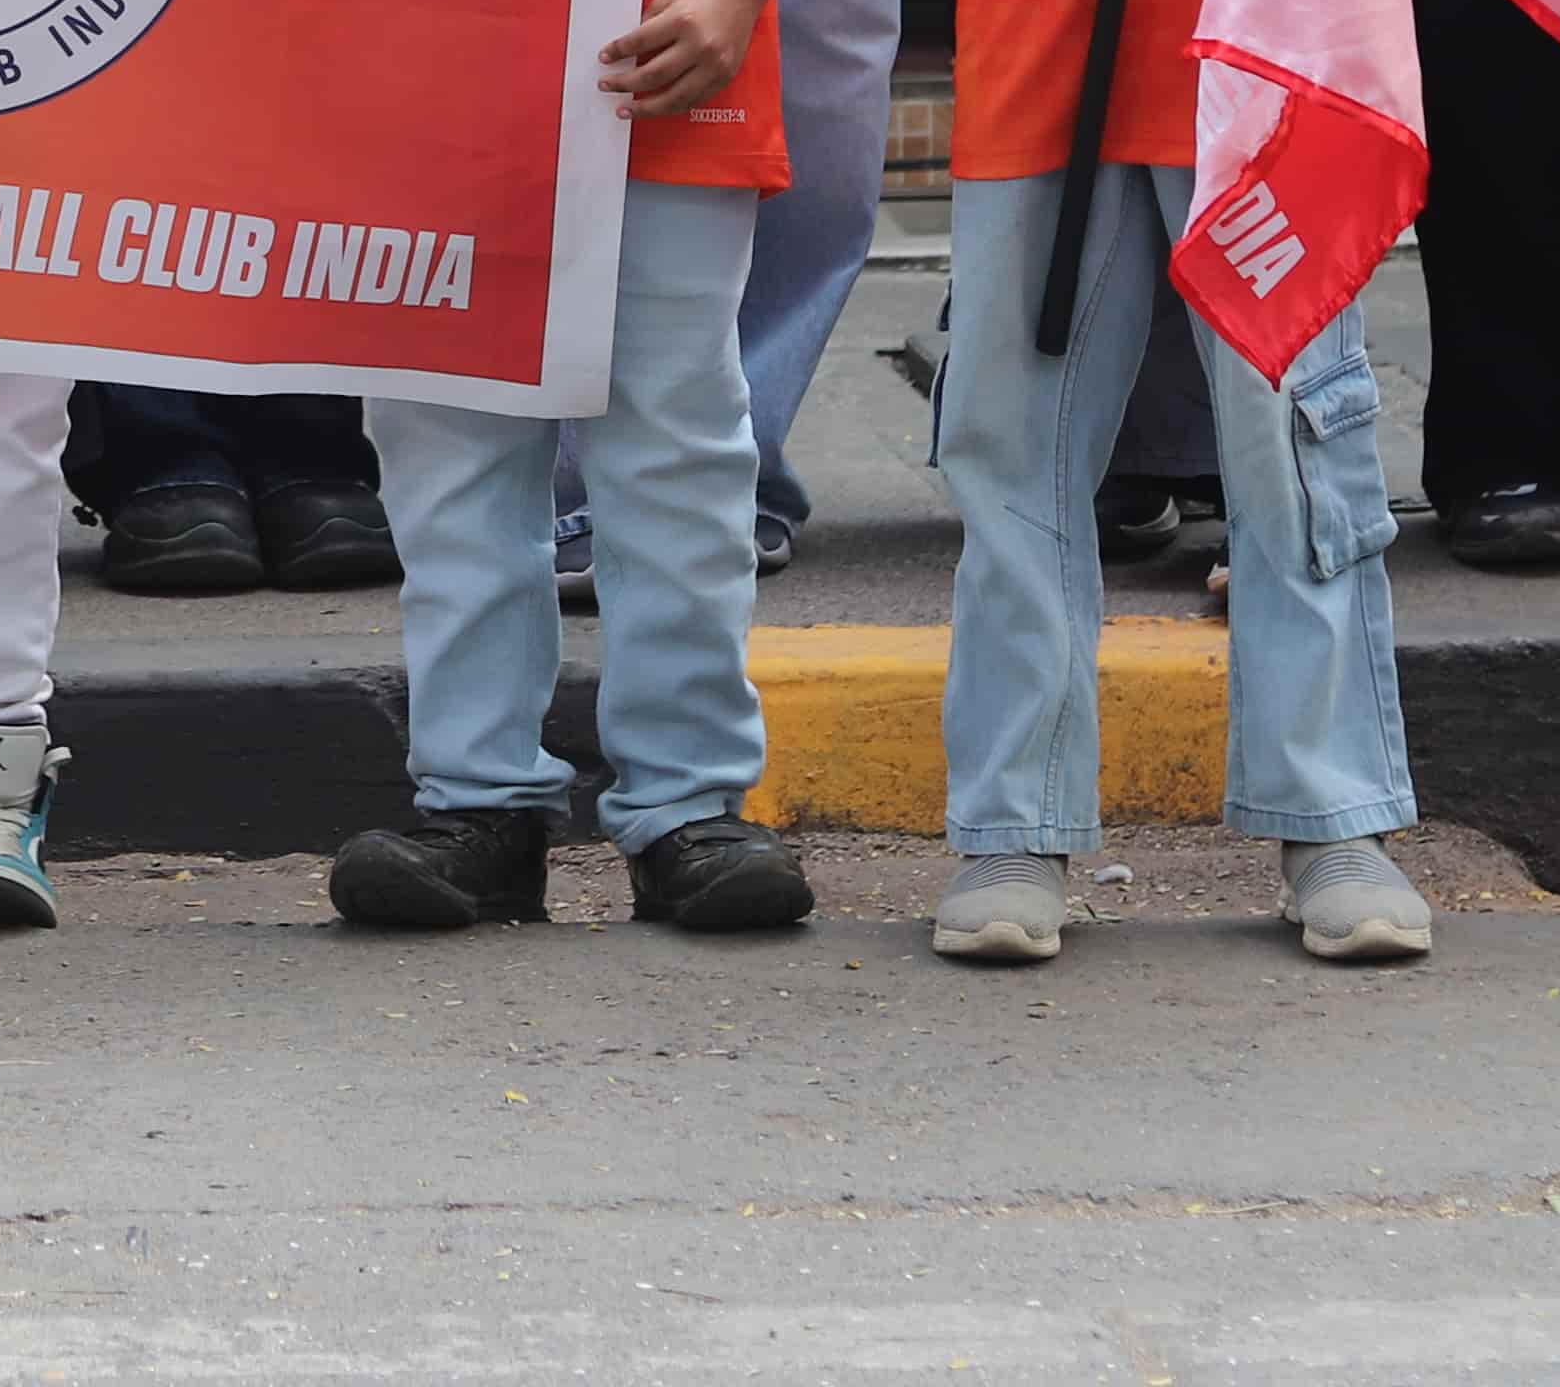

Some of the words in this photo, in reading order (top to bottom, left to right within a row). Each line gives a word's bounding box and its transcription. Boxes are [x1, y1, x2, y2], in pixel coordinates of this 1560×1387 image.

[97, 198, 275, 297] CLUB
[282, 220, 474, 309] INDIA
[1206, 180, 1307, 301] DIA
